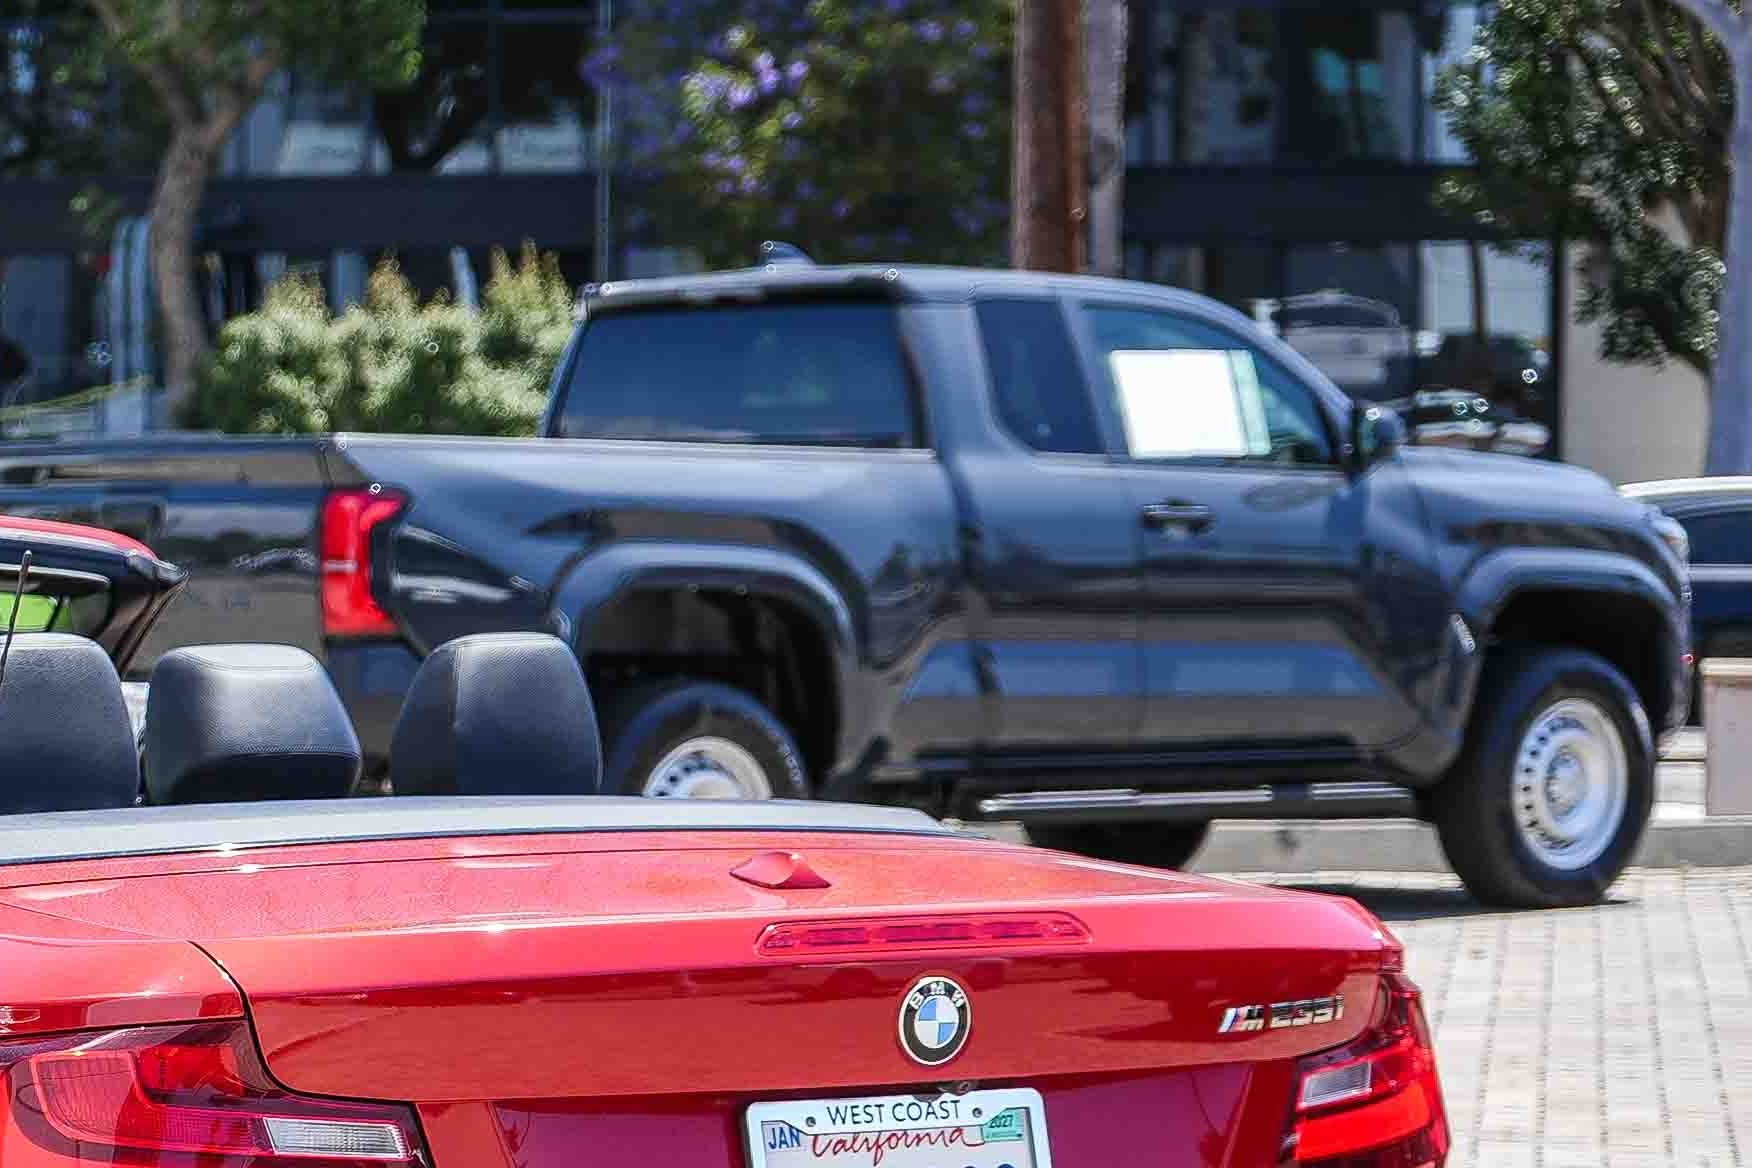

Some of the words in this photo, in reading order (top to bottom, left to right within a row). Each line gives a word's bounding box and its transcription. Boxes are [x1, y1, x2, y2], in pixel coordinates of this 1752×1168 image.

[826, 1103, 885, 1126] WEST
[891, 1099, 961, 1122] COAST
[767, 1126, 801, 1150] JAN
